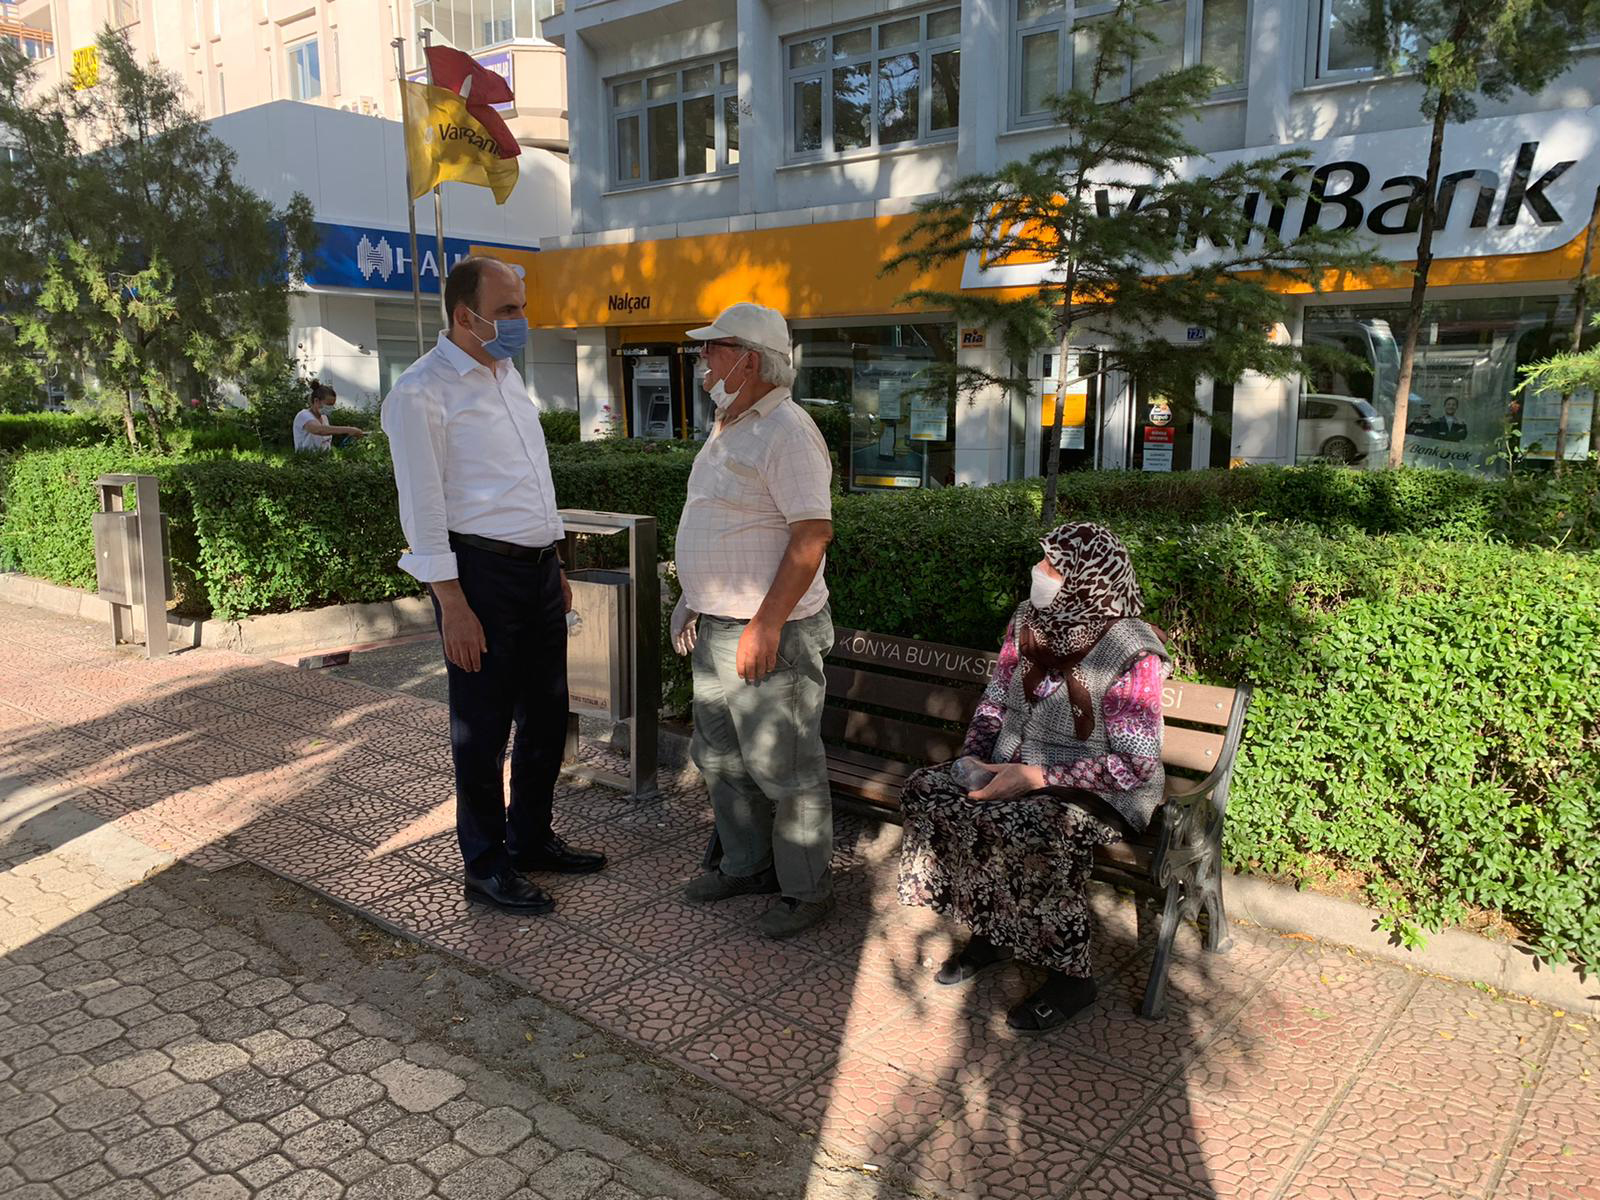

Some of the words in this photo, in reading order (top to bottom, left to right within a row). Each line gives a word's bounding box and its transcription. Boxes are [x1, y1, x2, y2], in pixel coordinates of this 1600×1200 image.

[608, 292, 651, 313] Nalçacı
[963, 328, 984, 343] Ria
[840, 636, 900, 660] KONYA
